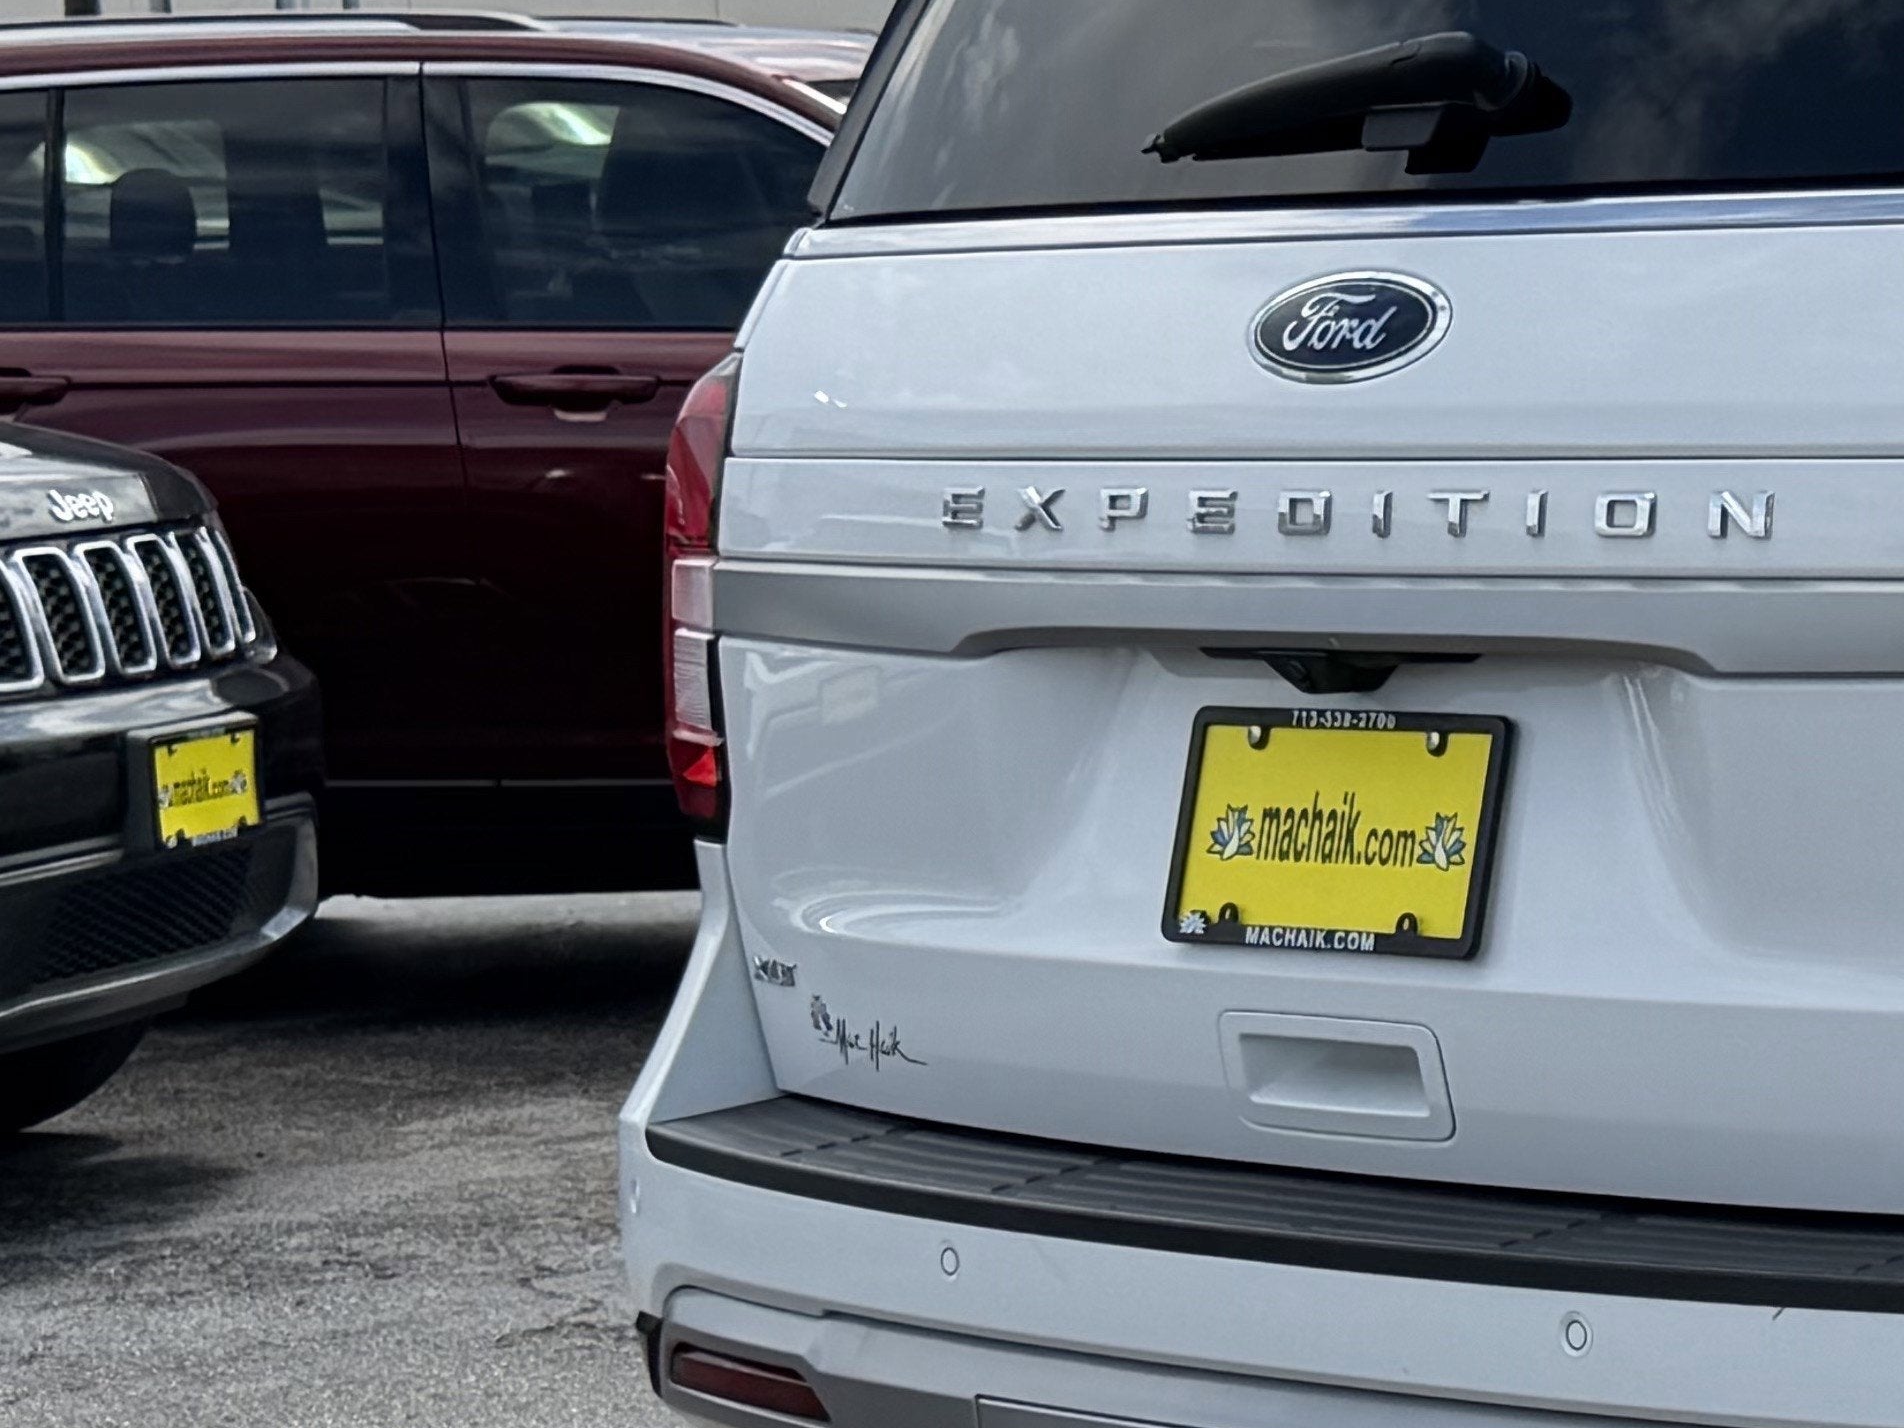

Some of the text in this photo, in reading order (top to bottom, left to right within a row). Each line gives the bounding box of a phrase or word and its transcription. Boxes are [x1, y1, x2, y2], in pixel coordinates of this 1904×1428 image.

[1282, 292, 1398, 351] Ford
[48, 489, 114, 522] Jeep
[941, 484, 1775, 540] EXPEDITION
[1256, 790, 1416, 868] machaik.com
[1245, 926, 1376, 951] MACHAIK.COM
